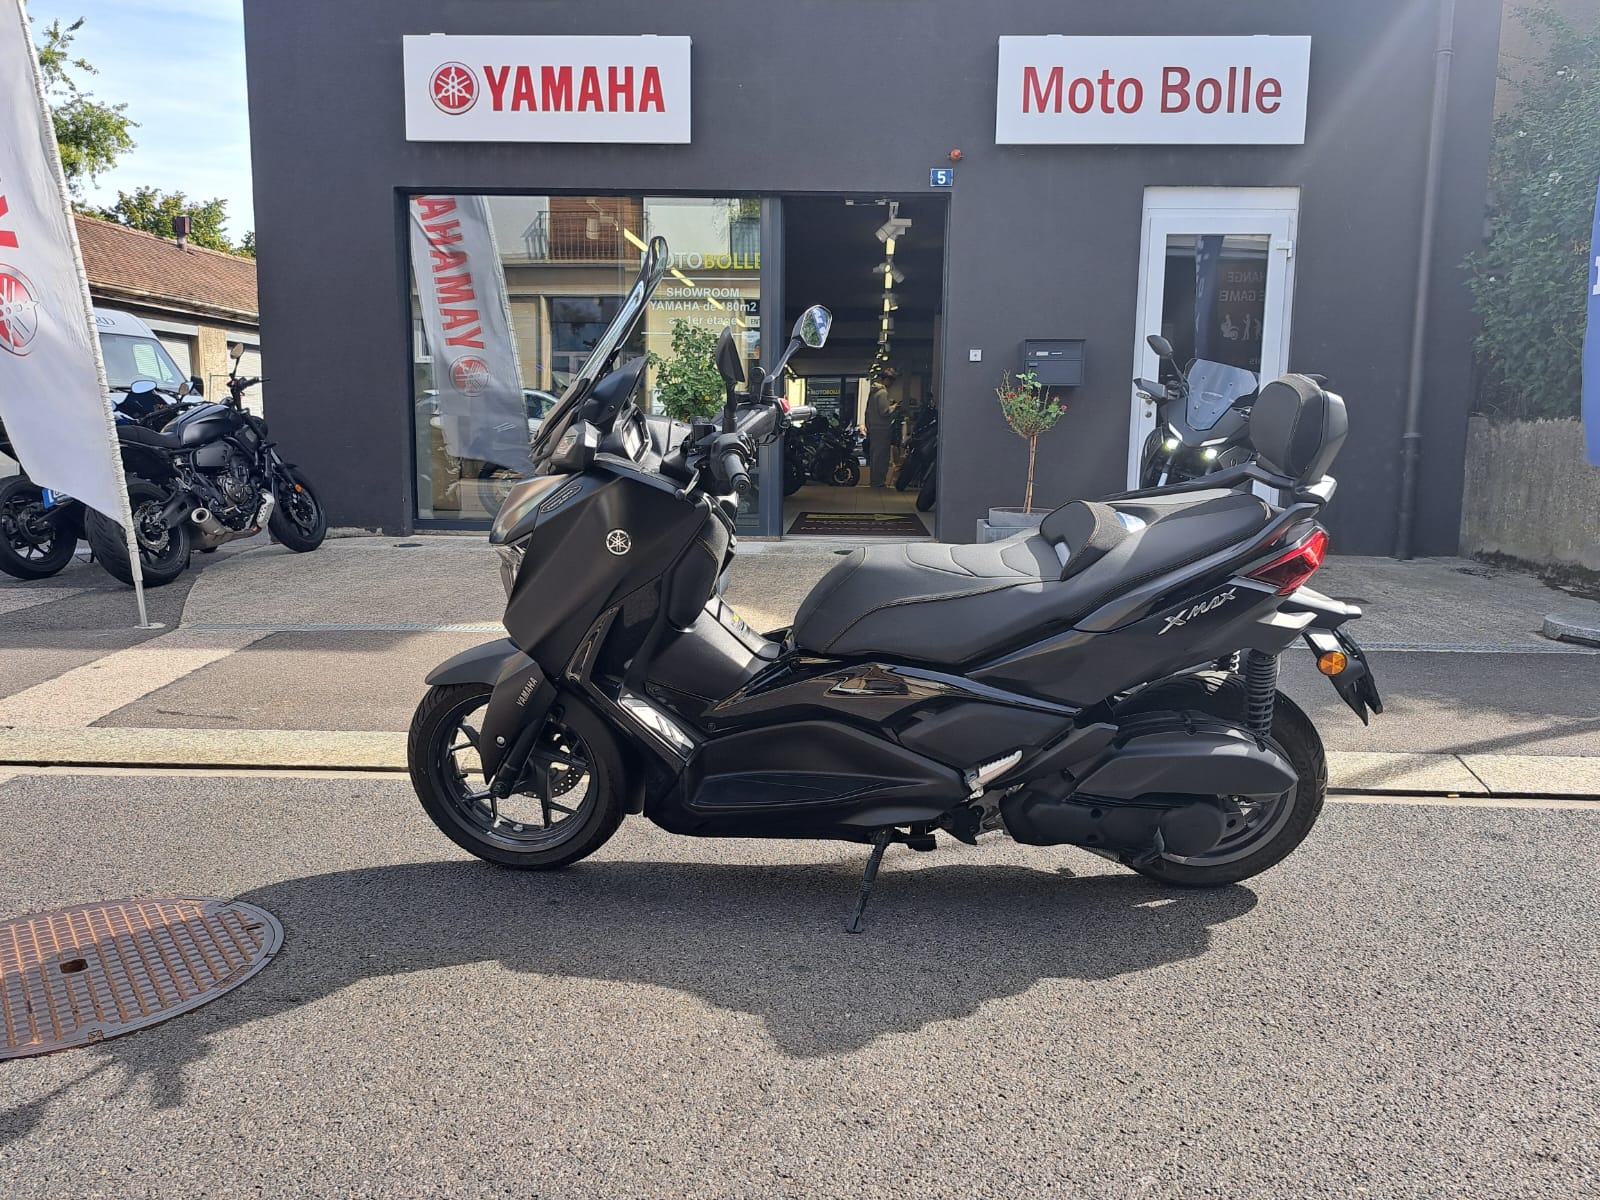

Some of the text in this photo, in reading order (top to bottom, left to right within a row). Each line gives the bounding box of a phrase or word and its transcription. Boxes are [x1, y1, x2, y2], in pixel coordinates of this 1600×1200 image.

[483, 65, 666, 113] YAMAHA
[1021, 66, 1283, 115] Moto Bolle
[937, 170, 946, 185] 5
[666, 287, 740, 298] SHOWROOM
[650, 300, 700, 312] YAMAHA
[703, 300, 717, 312] de
[515, 677, 538, 707] YAMAHA
